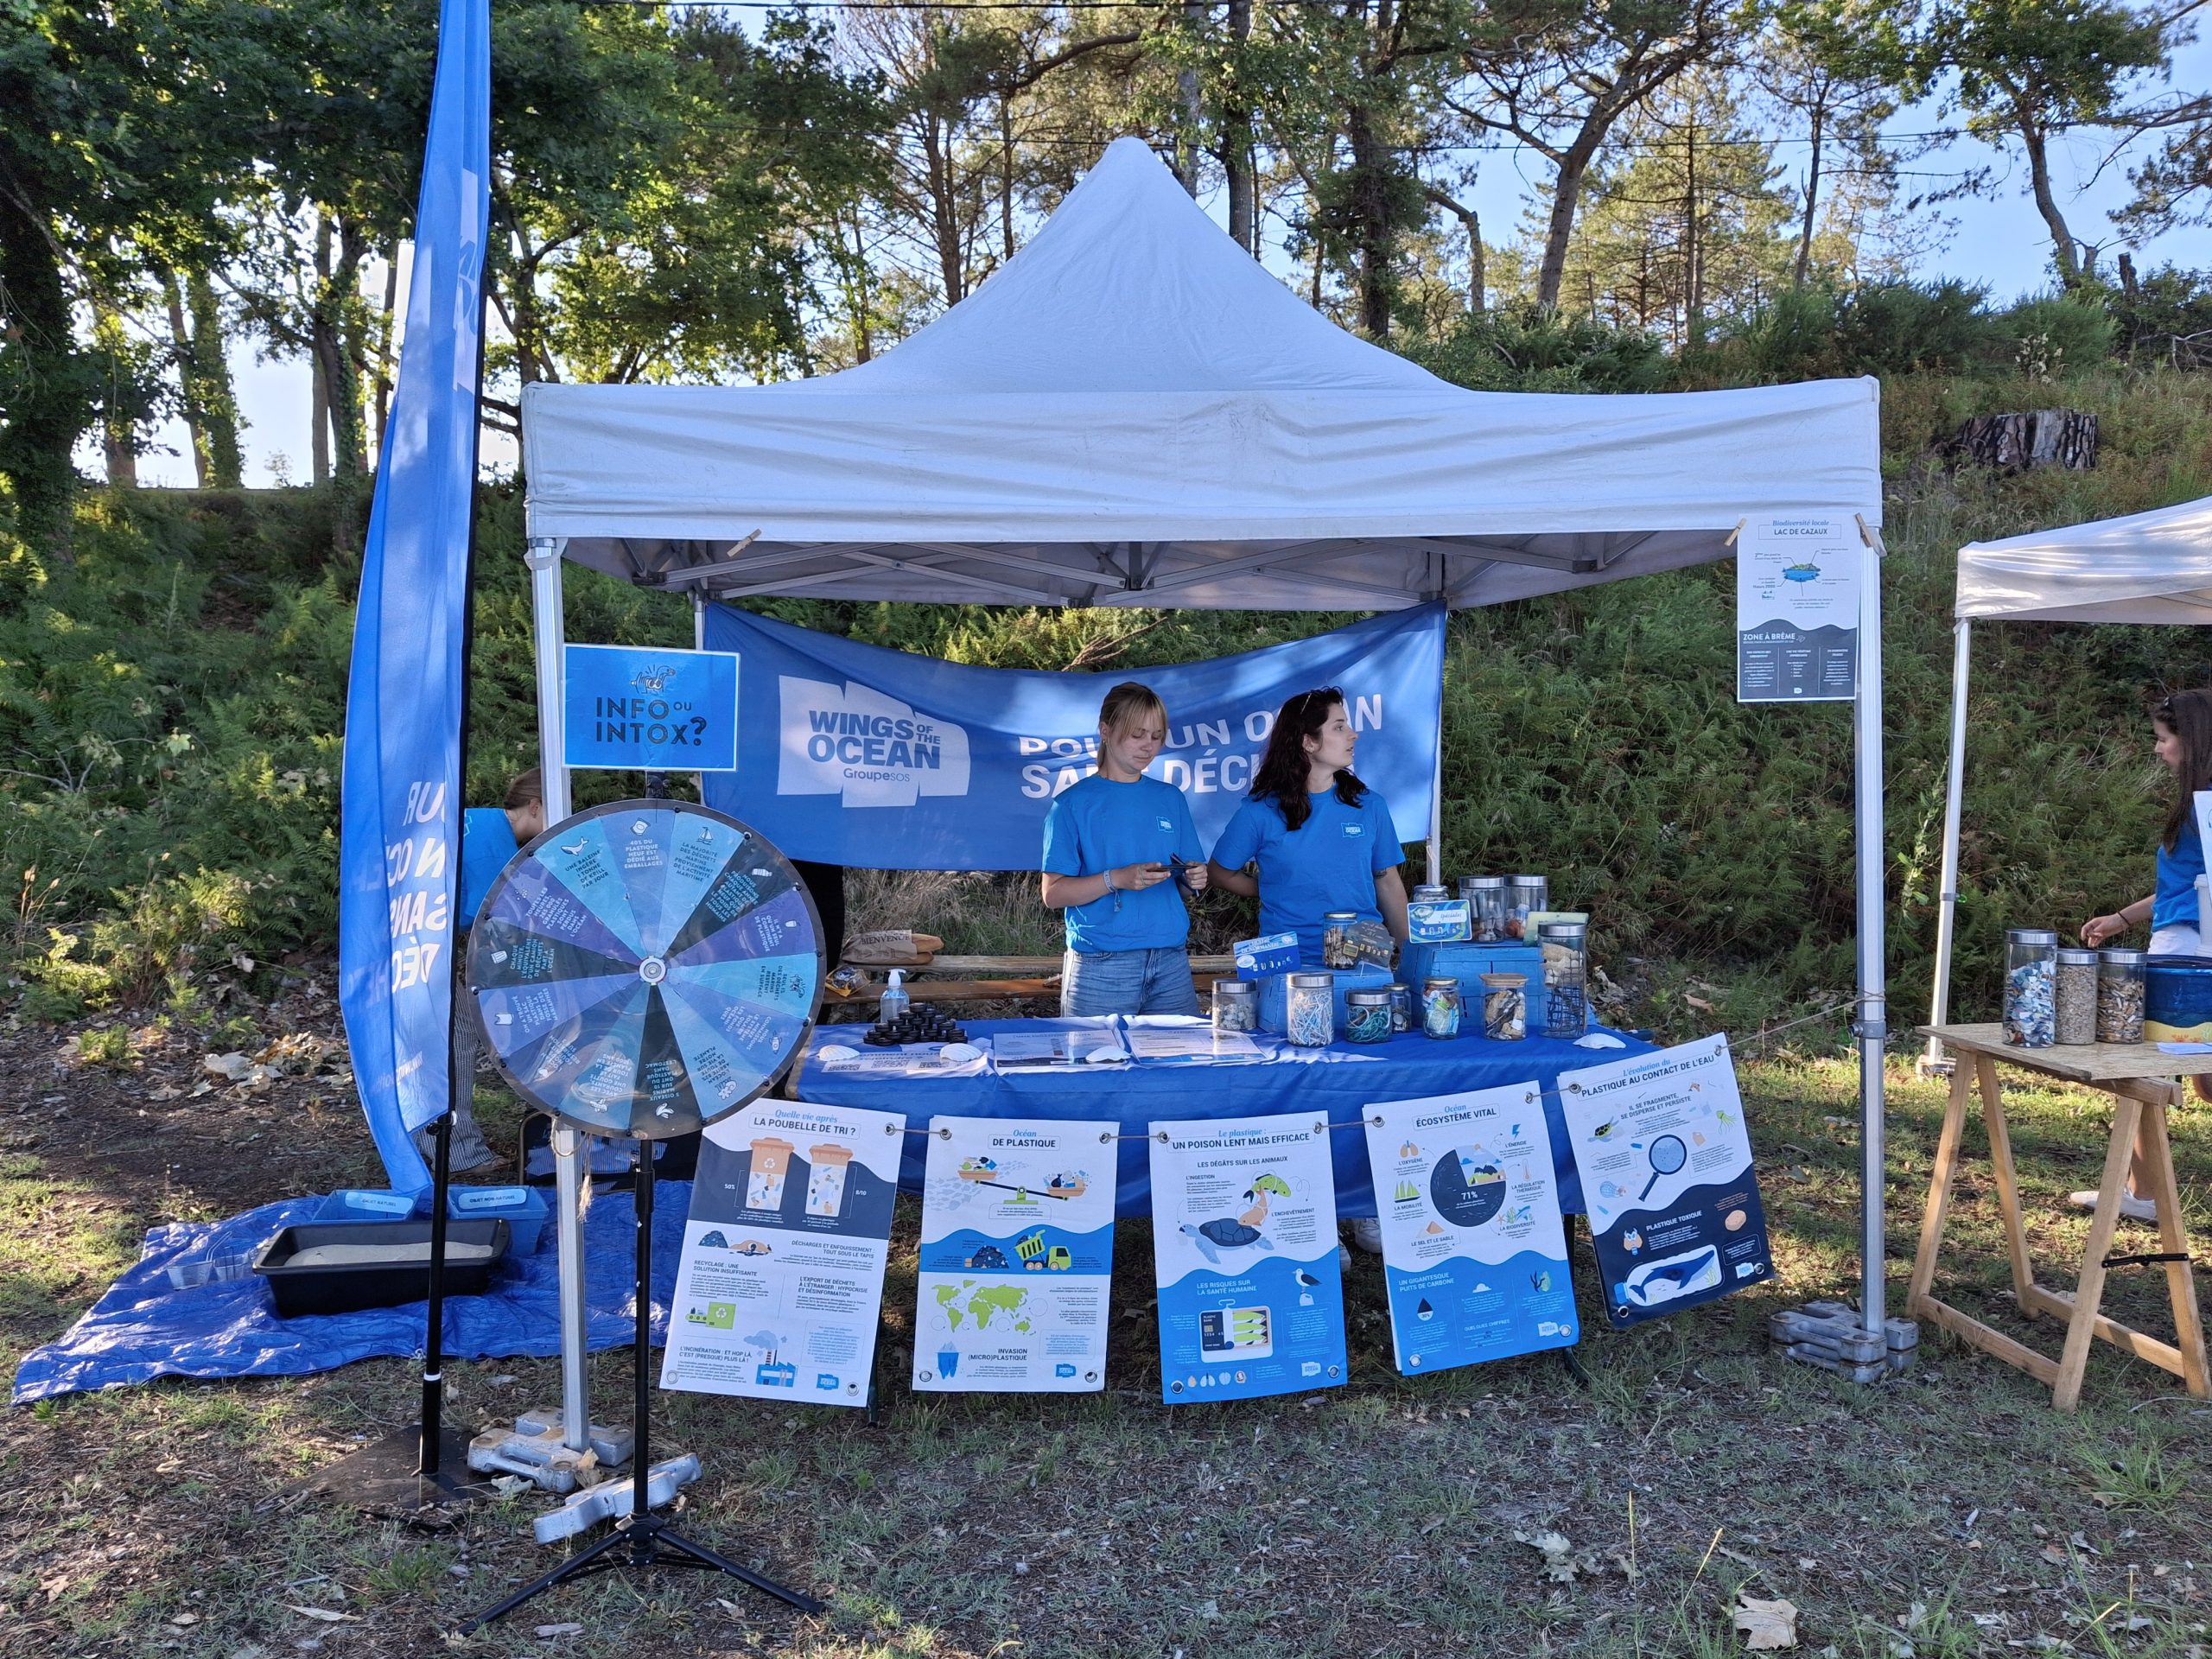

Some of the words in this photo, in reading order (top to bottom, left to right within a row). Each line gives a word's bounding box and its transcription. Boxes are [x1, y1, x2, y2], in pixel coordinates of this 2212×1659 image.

[1765, 632, 1770, 640] À
[596, 697, 669, 720] INFO
[674, 702, 692, 711] OU
[596, 716, 707, 746] INTOX?
[809, 710, 914, 740] WINGS
[916, 724, 934, 734] OF
[916, 733, 941, 744] THE
[807, 734, 941, 769] OCEAN
[1019, 736, 1099, 758] POU
[691, 845, 718, 857] MAJORITÉ
[692, 851, 716, 863] DÉCHETS
[624, 860, 663, 869] EMBALLAGES
[675, 857, 713, 873] PROVIENNENT
[686, 855, 707, 865] MARINS
[676, 870, 703, 882] MARITIME
[682, 865, 710, 878] L'ACTIVITÉ
[861, 934, 910, 945] BIENVENUE
[1622, 1061, 1660, 1076] L'évolution
[1660, 1058, 1670, 1066] du
[1581, 1079, 1627, 1097] PLASTIQUE
[1628, 1075, 1641, 1084] AU
[1641, 1065, 1679, 1081] CONTACT
[1679, 1062, 1690, 1070] DE
[1692, 1055, 1714, 1066] L'EAU
[1444, 1103, 1466, 1113] Océan
[1628, 1105, 1656, 1117] DISPERSE
[1664, 1096, 1691, 1107] PERSISTE
[775, 1108, 800, 1119] Quelle
[802, 1112, 813, 1120] vie
[815, 1113, 838, 1124] après
[1415, 1110, 1471, 1127] ÉCOSYSTÈME
[1473, 1108, 1496, 1118] VITAL
[754, 1117, 766, 1126] LA
[768, 1118, 816, 1131] POUBELLE
[818, 1124, 831, 1133] DE
[833, 1125, 848, 1134] TRI
[1013, 1128, 1036, 1137] Océan
[1228, 1128, 1262, 1138] plastique
[1006, 1138, 1055, 1147] PLASTIQUE
[1188, 1139, 1221, 1149] POISON
[1224, 1138, 1246, 1146] LENT
[1248, 1136, 1269, 1145] MAIS
[1271, 1133, 1309, 1143] EFFICACE
[1461, 1191, 1477, 1200] 71%
[1645, 1218, 1677, 1230] PLASTIQUE
[1678, 1210, 1702, 1221] TOXIQUE
[792, 1239, 821, 1247] DÉCHARGES
[830, 1244, 871, 1252] ENFOUISSEMENT
[1408, 1272, 1449, 1283] GIGANTESQUE
[1426, 1278, 1454, 1286] CARBONE
[805, 1287, 850, 1297] DÉSINFORMATION
[680, 1345, 720, 1354] L'INCINÉRATION
[968, 1353, 1027, 1362] (MICRO)PLASTIQUE
